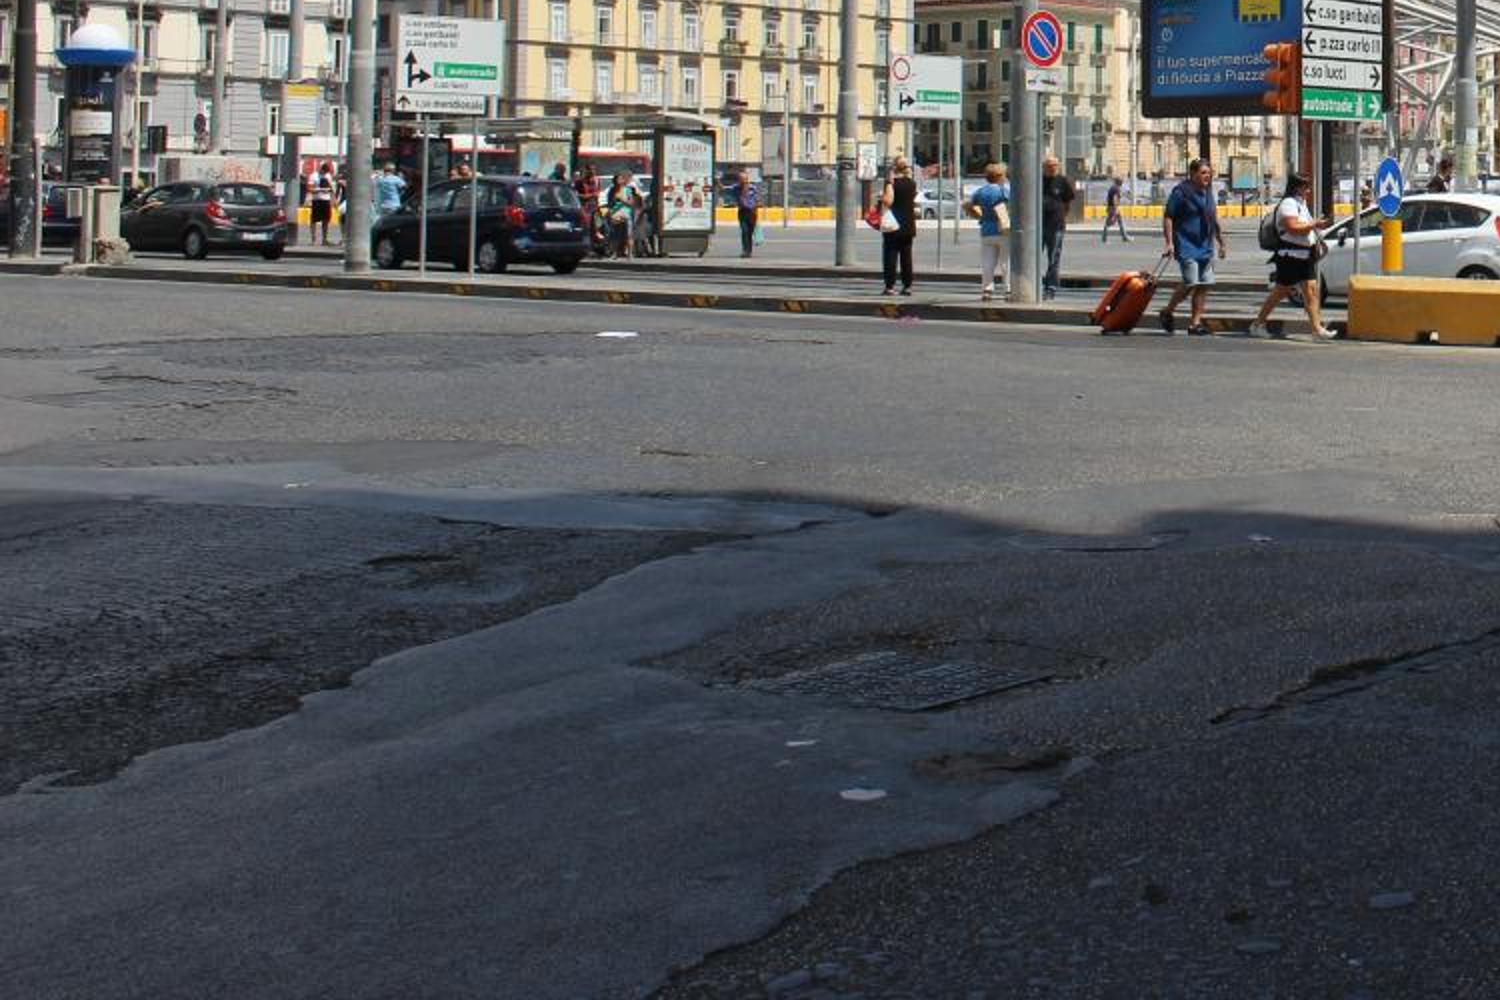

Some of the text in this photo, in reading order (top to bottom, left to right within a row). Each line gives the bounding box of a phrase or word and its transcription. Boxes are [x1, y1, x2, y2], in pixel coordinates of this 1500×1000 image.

[1339, 7, 1380, 25] garibaldi
[1346, 36, 1370, 53] carlo
[1325, 64, 1347, 81] lucci
[1303, 96, 1353, 113] autostrade
